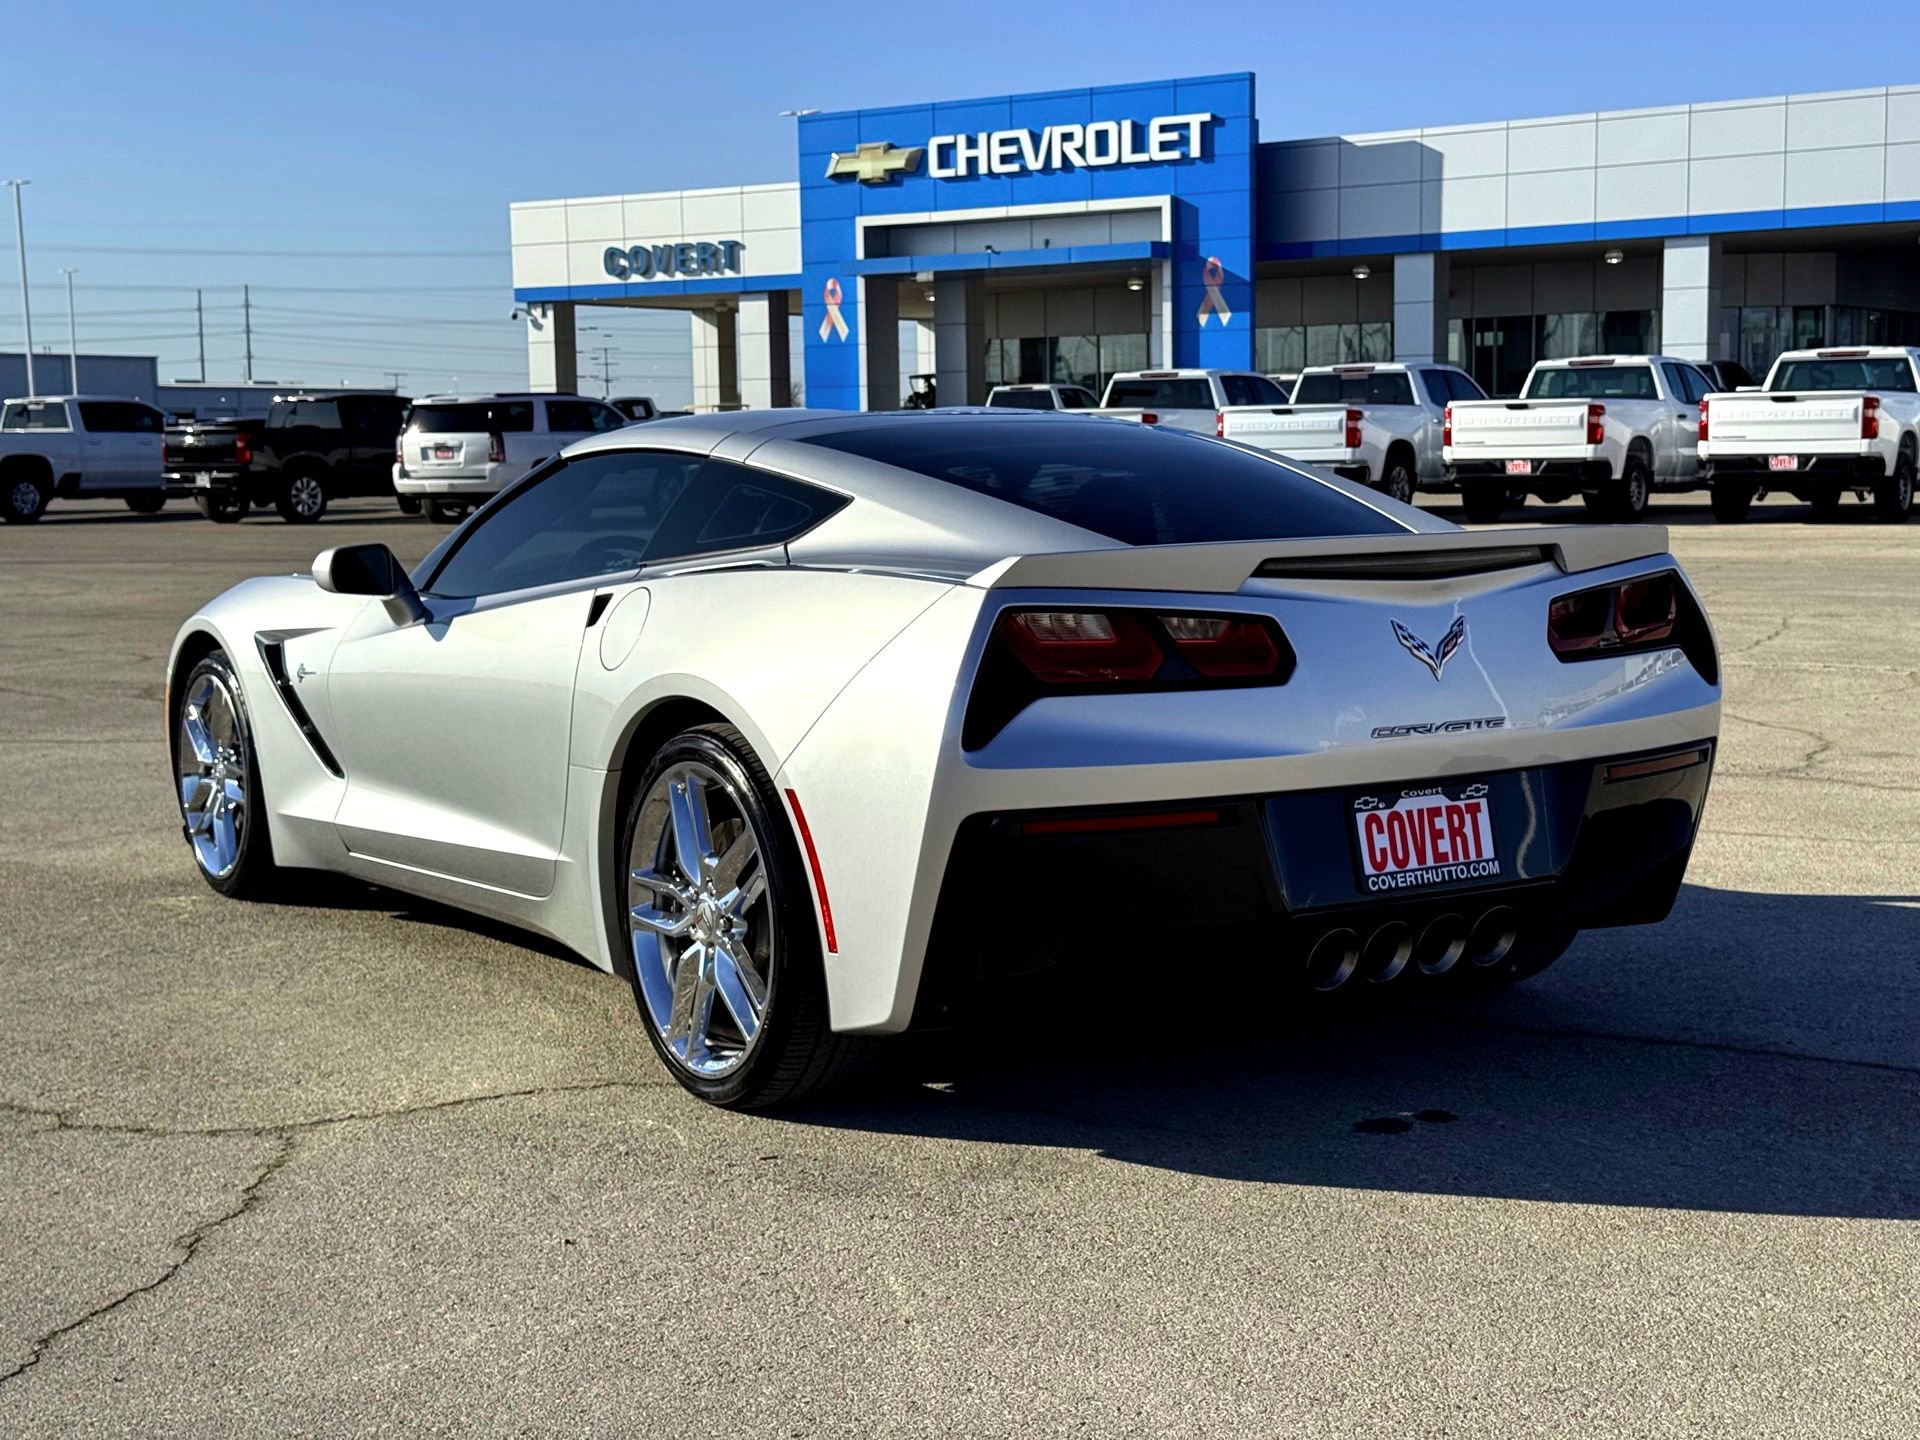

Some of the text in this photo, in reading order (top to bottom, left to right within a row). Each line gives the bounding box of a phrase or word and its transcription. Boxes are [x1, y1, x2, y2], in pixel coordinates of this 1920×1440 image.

[928, 112, 1212, 178] CHEVROLET
[604, 240, 745, 280] COVERT
[1371, 716, 1506, 738] CORVETTE
[1400, 787, 1443, 798] Covert
[1364, 802, 1483, 873] COVERT
[1368, 860, 1500, 891] COVERTHUTTO.COM
